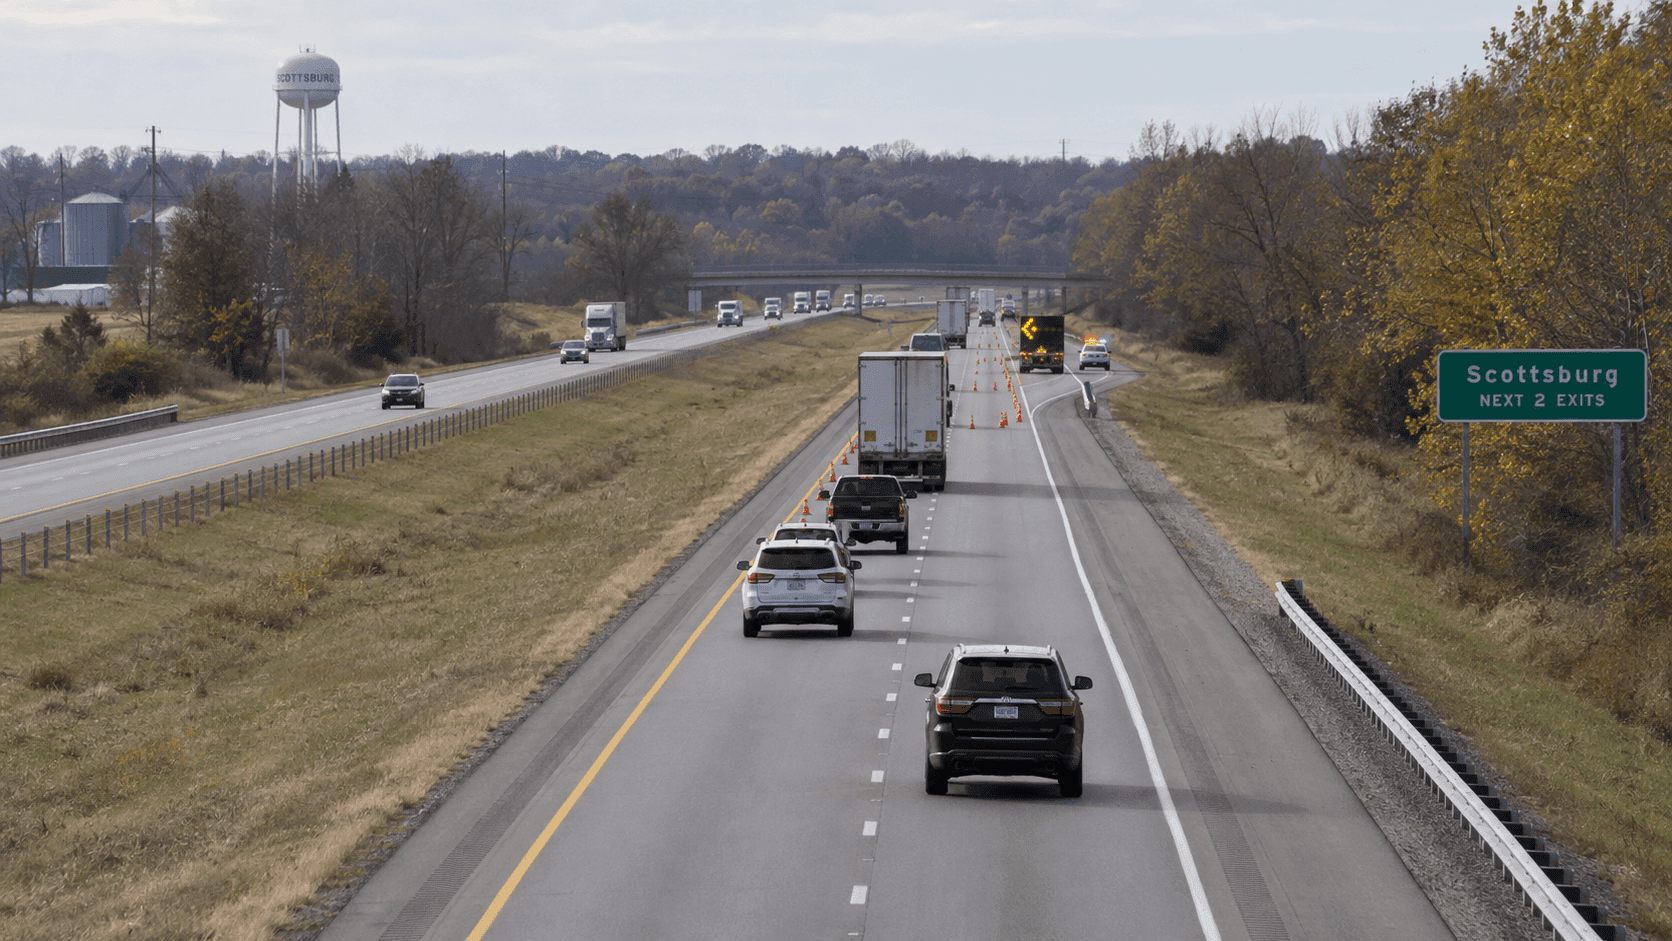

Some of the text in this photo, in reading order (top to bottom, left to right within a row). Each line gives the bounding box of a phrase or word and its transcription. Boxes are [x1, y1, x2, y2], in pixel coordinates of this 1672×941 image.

[277, 73, 335, 83] SCOTTSBURG
[1467, 365, 1618, 388] Scottsburg
[1480, 393, 1605, 407] NEXT 2 EXITS
